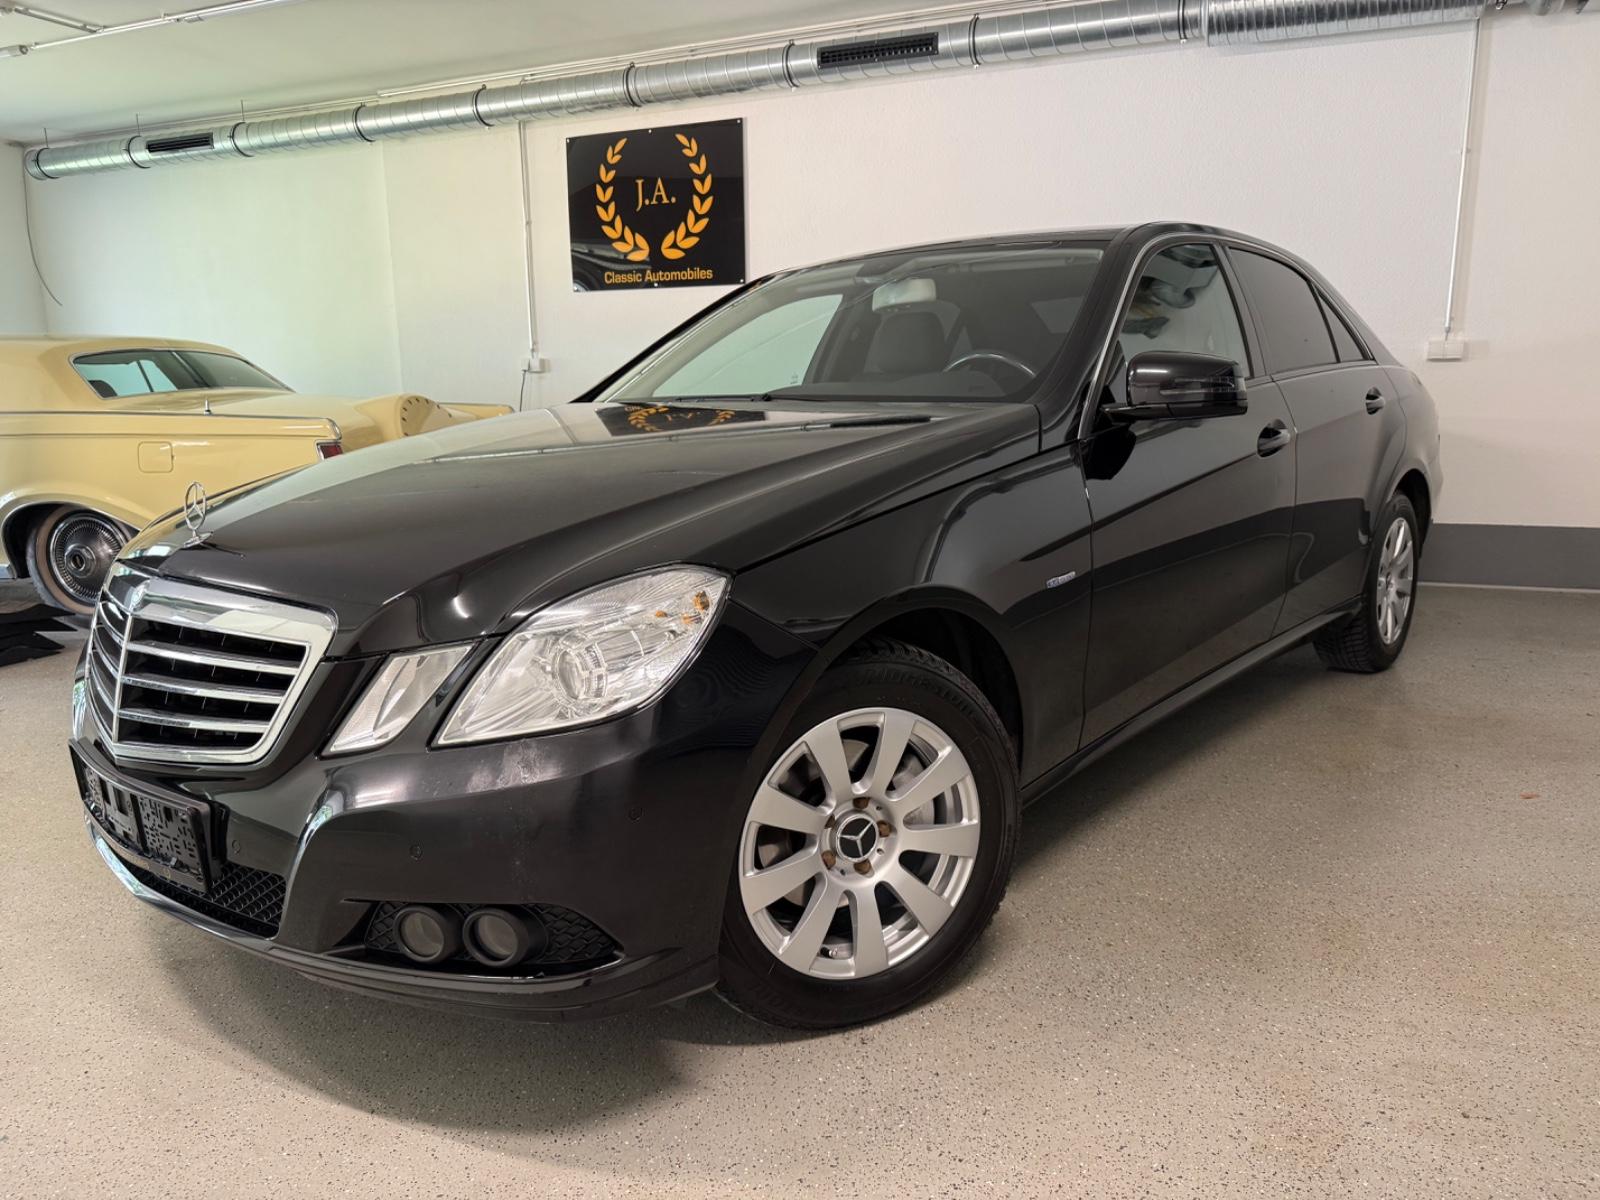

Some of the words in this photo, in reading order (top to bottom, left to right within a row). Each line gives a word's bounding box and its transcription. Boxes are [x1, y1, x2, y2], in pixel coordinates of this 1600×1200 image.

[636, 177, 676, 211] J.A.
[604, 271, 642, 284] Classic
[644, 267, 713, 281] Automobiles
